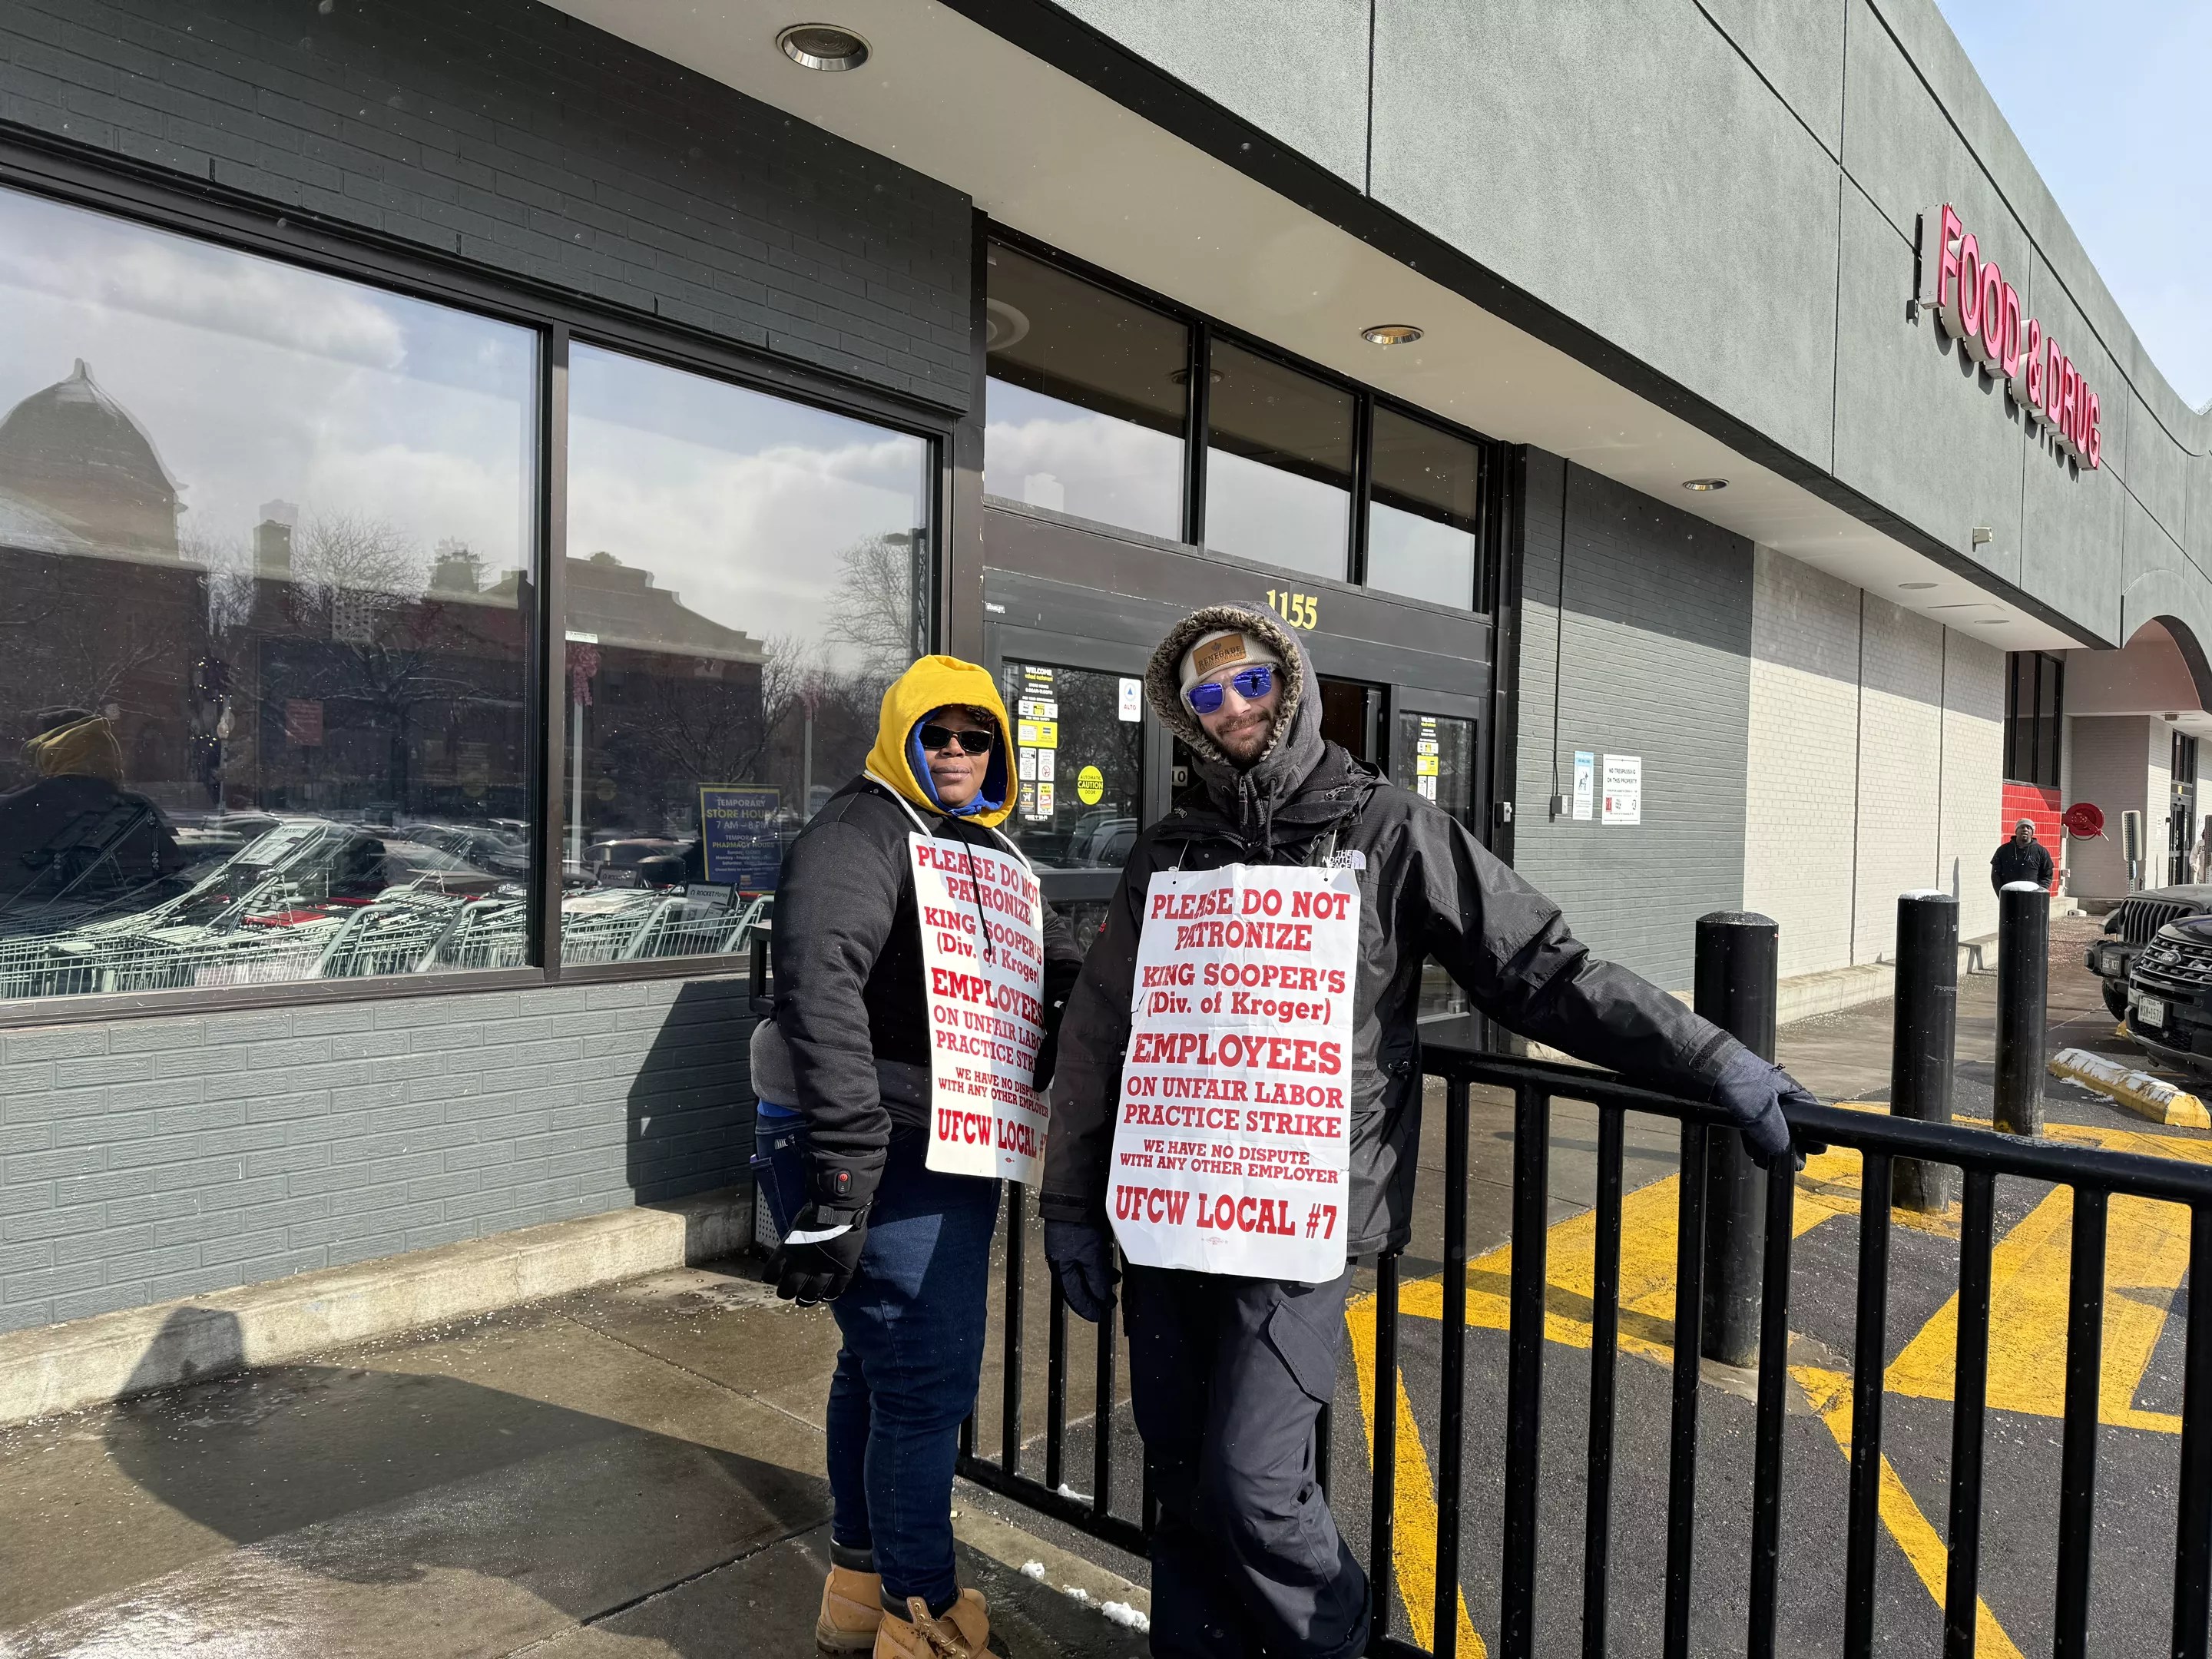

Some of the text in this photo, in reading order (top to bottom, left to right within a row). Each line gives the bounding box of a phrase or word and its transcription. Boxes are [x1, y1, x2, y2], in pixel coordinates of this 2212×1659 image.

[1935, 202, 2101, 470] FOOD & DRUG
[1267, 589, 1318, 630] 1155
[1198, 646, 1240, 667] RENEGADE
[1078, 781, 1103, 790] CAUTION
[707, 809, 773, 820] STORE HOUR
[717, 799, 766, 807] TEMPORARY
[724, 820, 738, 830] AM
[916, 845, 1038, 909] PLEASE DO NOT
[1322, 856, 1352, 864] NORTH
[946, 876, 1031, 927] PATRONIZE
[1151, 888, 1350, 920] PLEASE DO NOT
[924, 906, 1042, 966] KING SOOPER'S
[1174, 920, 1313, 952] PATRONIZE
[937, 932, 1039, 990] (Div. of Kroger)
[2162, 952, 2175, 962] Ford
[1142, 962, 1346, 994] KING SOOPER'S
[931, 966, 1045, 1030] EMPLOYEES
[1147, 991, 1331, 1025] (Div. of Kroger)
[933, 1005, 1042, 1051] ON UNFAIR LABO
[935, 1030, 1014, 1065] PRACTICE
[1132, 1033, 1342, 1075] EMPLOYEES
[955, 1067, 972, 1081] WE
[974, 1070, 999, 1088] HAVE
[1001, 1077, 1013, 1091] NO
[1127, 1076, 1344, 1109] ON UNFAIR LABOR
[939, 1078, 1049, 1118] WITH ANY OTHER EMPLOYER
[938, 1108, 992, 1146] UFCW
[997, 1118, 1037, 1159] LOCAL
[1124, 1103, 1341, 1138] PRACTICE STRIKE
[1120, 1153, 1339, 1184] WITH ANY OTHER EMPLOYER
[1144, 1139, 1310, 1166] WE HAVE NO DISPUTE
[1115, 1184, 1337, 1240] UFCW LOCAL #7
